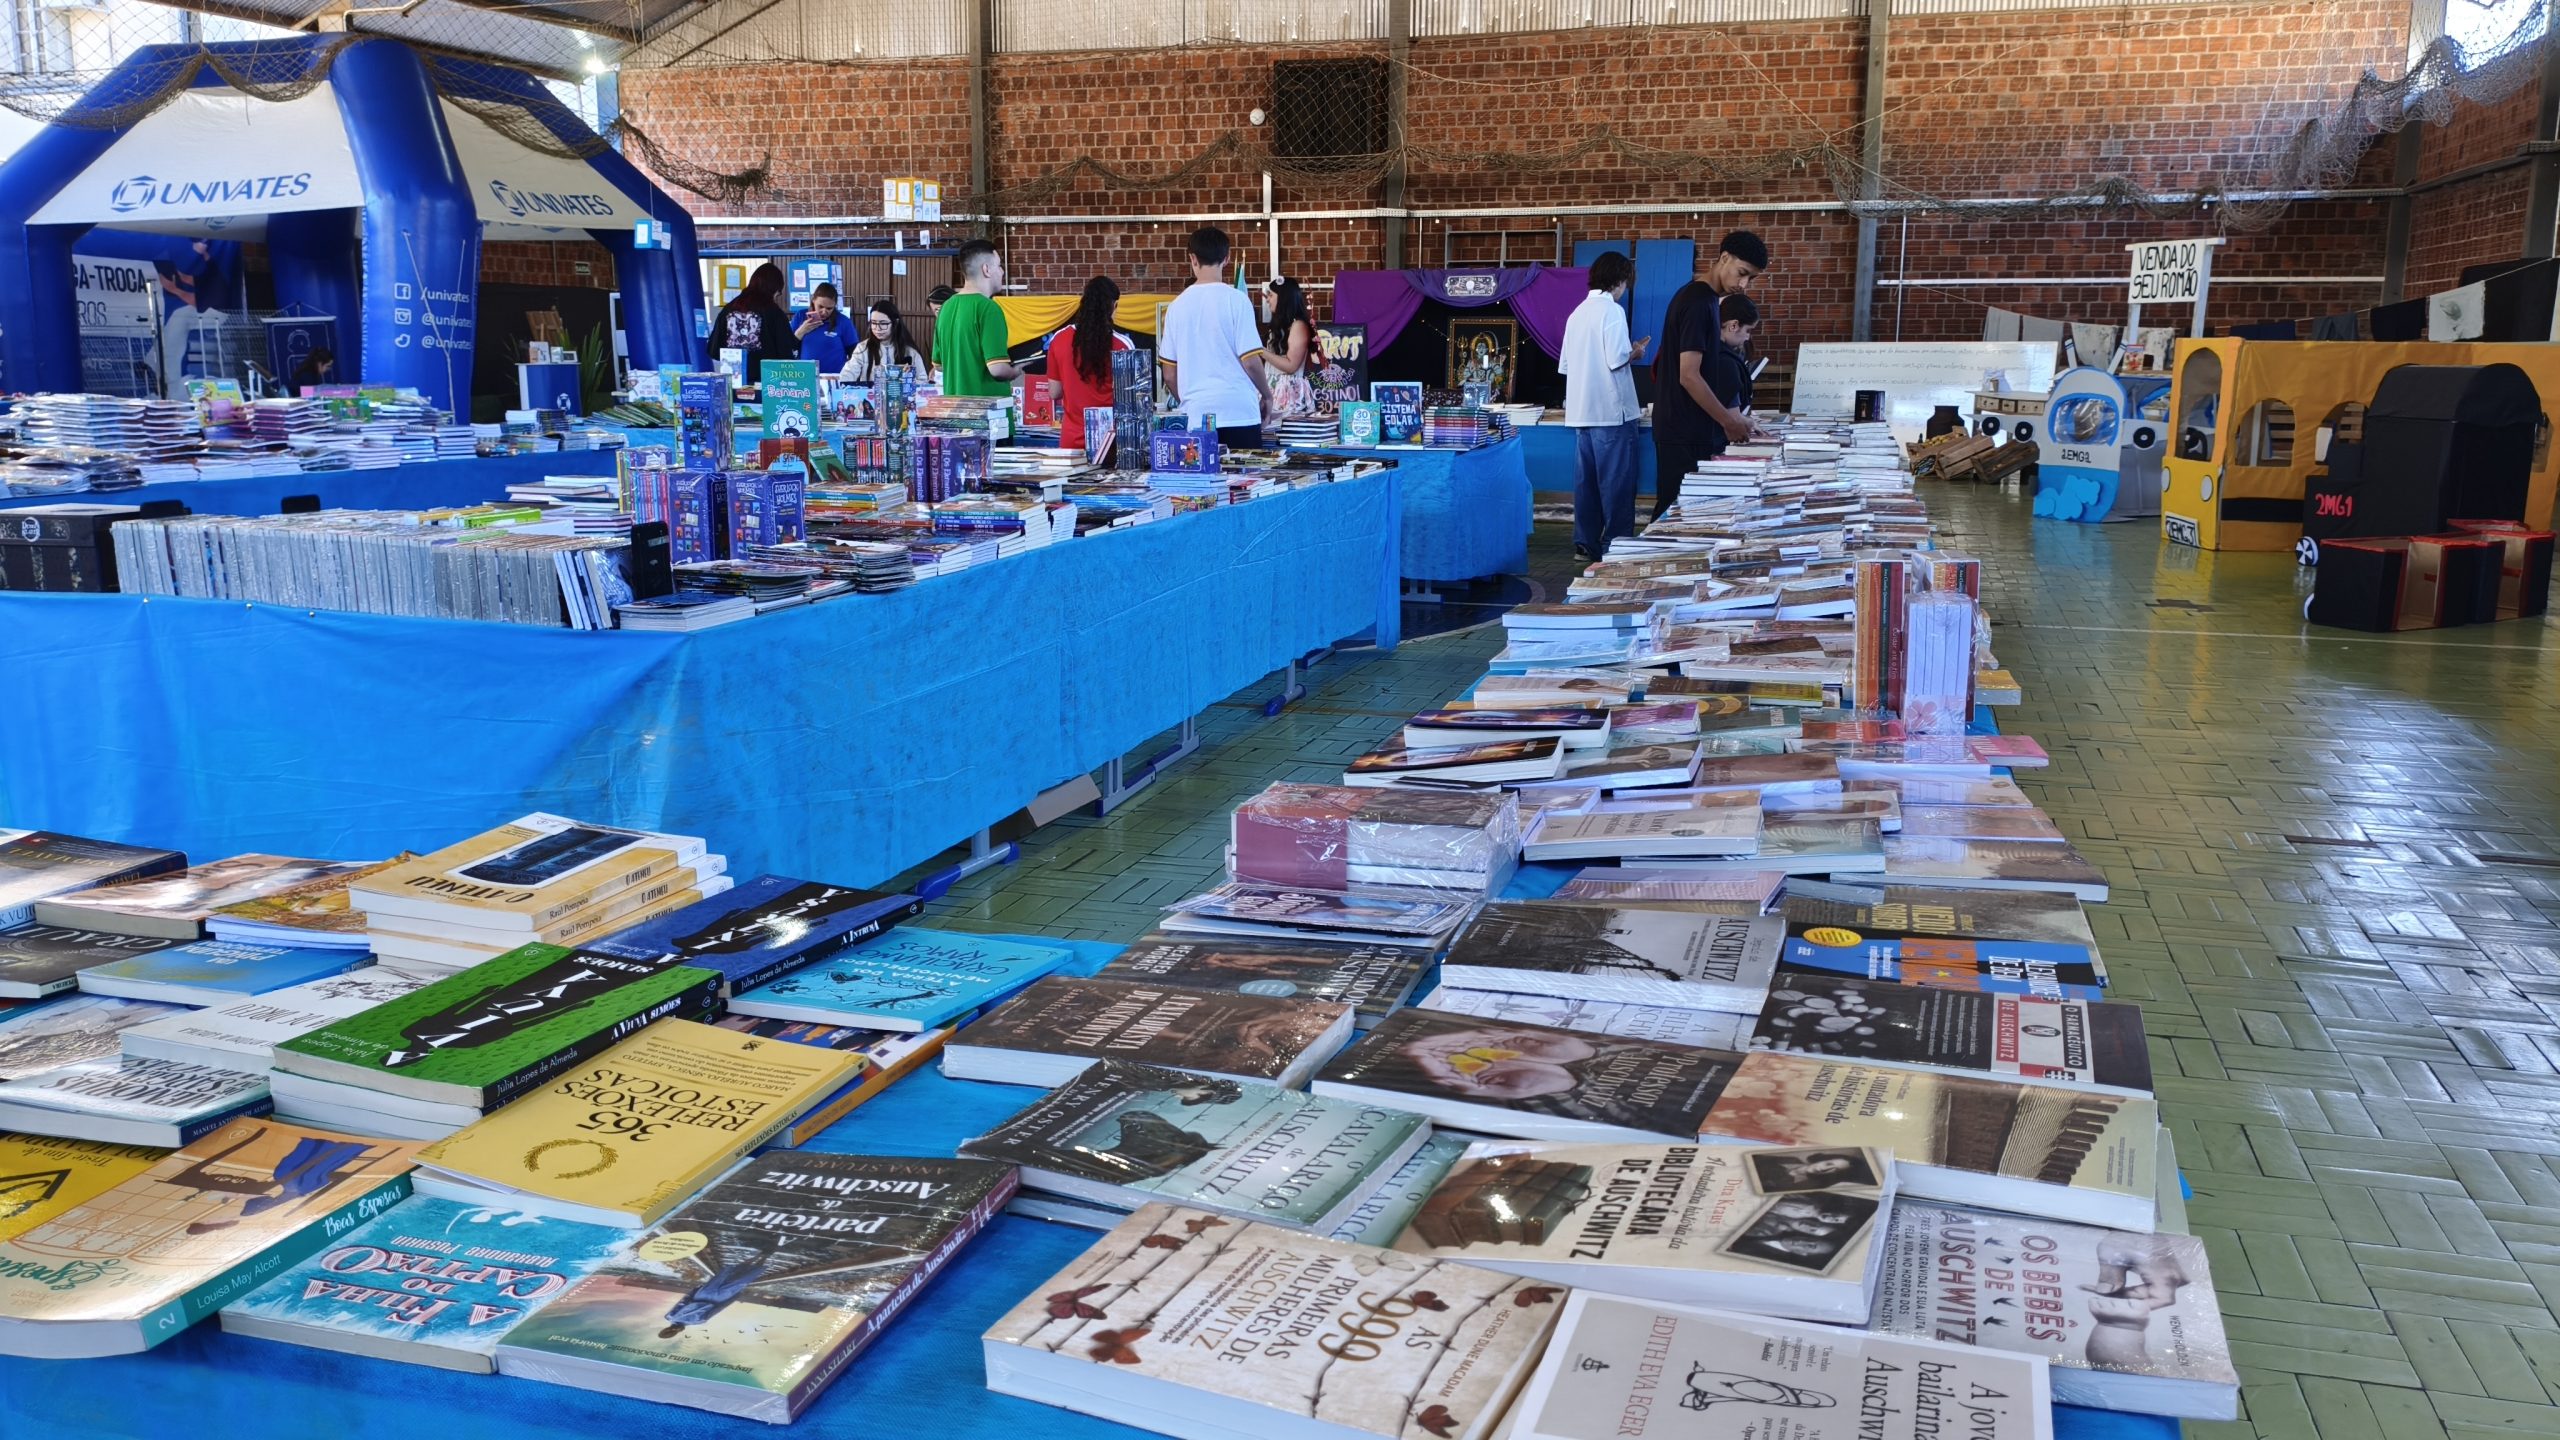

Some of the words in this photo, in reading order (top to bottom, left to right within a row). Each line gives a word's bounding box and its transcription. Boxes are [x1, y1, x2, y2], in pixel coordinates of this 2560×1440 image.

[161, 173, 312, 205] UNIVATES
[527, 193, 614, 216] UNIVATES
[2139, 245, 2177, 271] VENDA
[2181, 243, 2197, 267] DO
[2132, 274, 2158, 299] SEU
[2160, 268, 2198, 298] ROMÃO
[1356, 411, 1368, 419] 30
[1381, 401, 1417, 415] SISTEMA
[1384, 415, 1414, 425] SOLAR
[2315, 493, 2353, 517] 2MG1
[404, 876, 515, 901] ATENEU
[511, 892, 533, 903] O
[549, 907, 564, 920] Raul
[631, 866, 652, 884] ATENEU
[559, 927, 574, 940] Raul
[648, 882, 669, 901] ATENEU
[890, 942, 988, 961] RAMOS
[1132, 945, 1174, 971] MORRIS
[1148, 945, 1195, 974] HEATHER
[1701, 917, 1750, 982] AUSCHWITZ
[574, 956, 655, 973] SIMÕES
[758, 969, 774, 986] Lopes
[784, 954, 805, 975] Almeida
[838, 959, 911, 971] PELADOS
[851, 968, 885, 977] DOS
[912, 969, 991, 984] MENINOS
[892, 972, 944, 984] TERRA
[1125, 990, 1163, 1000] DE
[1169, 993, 1202, 1001] A
[2001, 1002, 2014, 1010] DE
[1063, 1001, 1147, 1047] AUSCHWITZ
[1106, 1001, 1195, 1050] ENXADRISTA
[1653, 1012, 1692, 1040] FILHA
[2000, 1013, 2015, 1059] AUSCHWITZ
[302, 1037, 342, 1054] Lopes
[320, 1031, 373, 1049] Almeida
[376, 1043, 389, 1052] de
[496, 1080, 516, 1096] Júlia
[518, 1070, 540, 1088] Lopes
[541, 1065, 552, 1077] de
[554, 1049, 578, 1071] Almeida
[611, 1027, 620, 1041] A
[649, 996, 681, 1020] SIMÕES
[2066, 1014, 2085, 1066] FARMACÊUTICO
[384, 1050, 432, 1067] A
[583, 1067, 770, 1116] ESTOICAS
[751, 1080, 792, 1093] MARCO
[1065, 1074, 1122, 1108] HENRY
[1830, 1075, 1868, 1111] histórias
[1859, 1076, 1890, 1116] contadora
[554, 1080, 754, 1132] REFLEXÕES
[1825, 1112, 1850, 1124] de
[193, 1123, 217, 1137] MANUEL
[575, 1111, 671, 1142] 365
[1003, 1111, 1064, 1145] OSTER
[22, 1147, 40, 1157] de
[45, 1148, 72, 1161] fim
[75, 1155, 112, 1167] Triste
[1198, 1104, 1326, 1196] AUSCHWITZ
[885, 1162, 947, 1177] ANNA
[1616, 1159, 1652, 1174] DE
[757, 1170, 951, 1201] Auschwitz
[1625, 1147, 1699, 1235] BIBLIOTECÁRIA
[817, 1198, 843, 1211] de
[1710, 1199, 1735, 1225] Kraus
[733, 1208, 889, 1236] parteira
[1569, 1178, 1641, 1259] AUSCHWITZ
[1674, 1206, 1703, 1235] história
[777, 1234, 797, 1247] A
[1668, 1238, 1688, 1250] da
[1903, 1241, 1914, 1255] VIDA
[1919, 1232, 1930, 1255] JOVENS
[2021, 1235, 2059, 1265] OS
[158, 1312, 176, 1330] 2
[197, 1284, 230, 1310] Louisa
[231, 1274, 252, 1297] May
[254, 1255, 281, 1282] Alcott
[323, 1211, 355, 1239] Boas
[358, 1184, 402, 1220] Esposas
[1883, 1243, 1898, 1295] CONCENTRAÇÃO
[1903, 1258, 1913, 1267] NO
[320, 1246, 569, 1300] CAPITÃO
[1900, 1269, 1912, 1297] HORROR
[1917, 1256, 1930, 1287] GRÁVIDAS
[1935, 1210, 1977, 1346] AUSCHWITZ
[1985, 1267, 2014, 1292] DE
[401, 1277, 456, 1295] DO
[1239, 1255, 1335, 1336] MULHERES
[302, 1278, 458, 1326] FILHA
[876, 1284, 911, 1330] parteira
[912, 1272, 923, 1290] de
[1189, 1250, 1304, 1350] AUSCHWITZ
[1899, 1300, 1910, 1315] DOS
[1916, 1296, 1926, 1309] SUA
[2022, 1269, 2079, 1344] BEBÊS
[467, 1303, 520, 1325] A
[1263, 1275, 1359, 1361] PRIMEIRAS
[1318, 1290, 1420, 1362] 999
[1479, 1308, 1512, 1339] HEATHER
[1915, 1311, 1926, 1330] LUTA
[2170, 1315, 2183, 1339] WENDY
[547, 1334, 570, 1345] real
[571, 1335, 607, 1351] história
[1404, 1325, 1440, 1351] AS
[1465, 1339, 1491, 1360] DUNE
[1641, 1315, 1679, 1359] EDITH
[608, 1343, 667, 1360] emocionante
[669, 1352, 691, 1364] uma
[693, 1357, 707, 1367] em
[1217, 1338, 1256, 1365] DE
[708, 1357, 753, 1376] Inspirado
[1438, 1359, 1477, 1398] MACADAM
[1633, 1360, 1661, 1394] EVA
[1969, 1382, 2010, 1400] A
[1617, 1396, 1651, 1437] EGER
